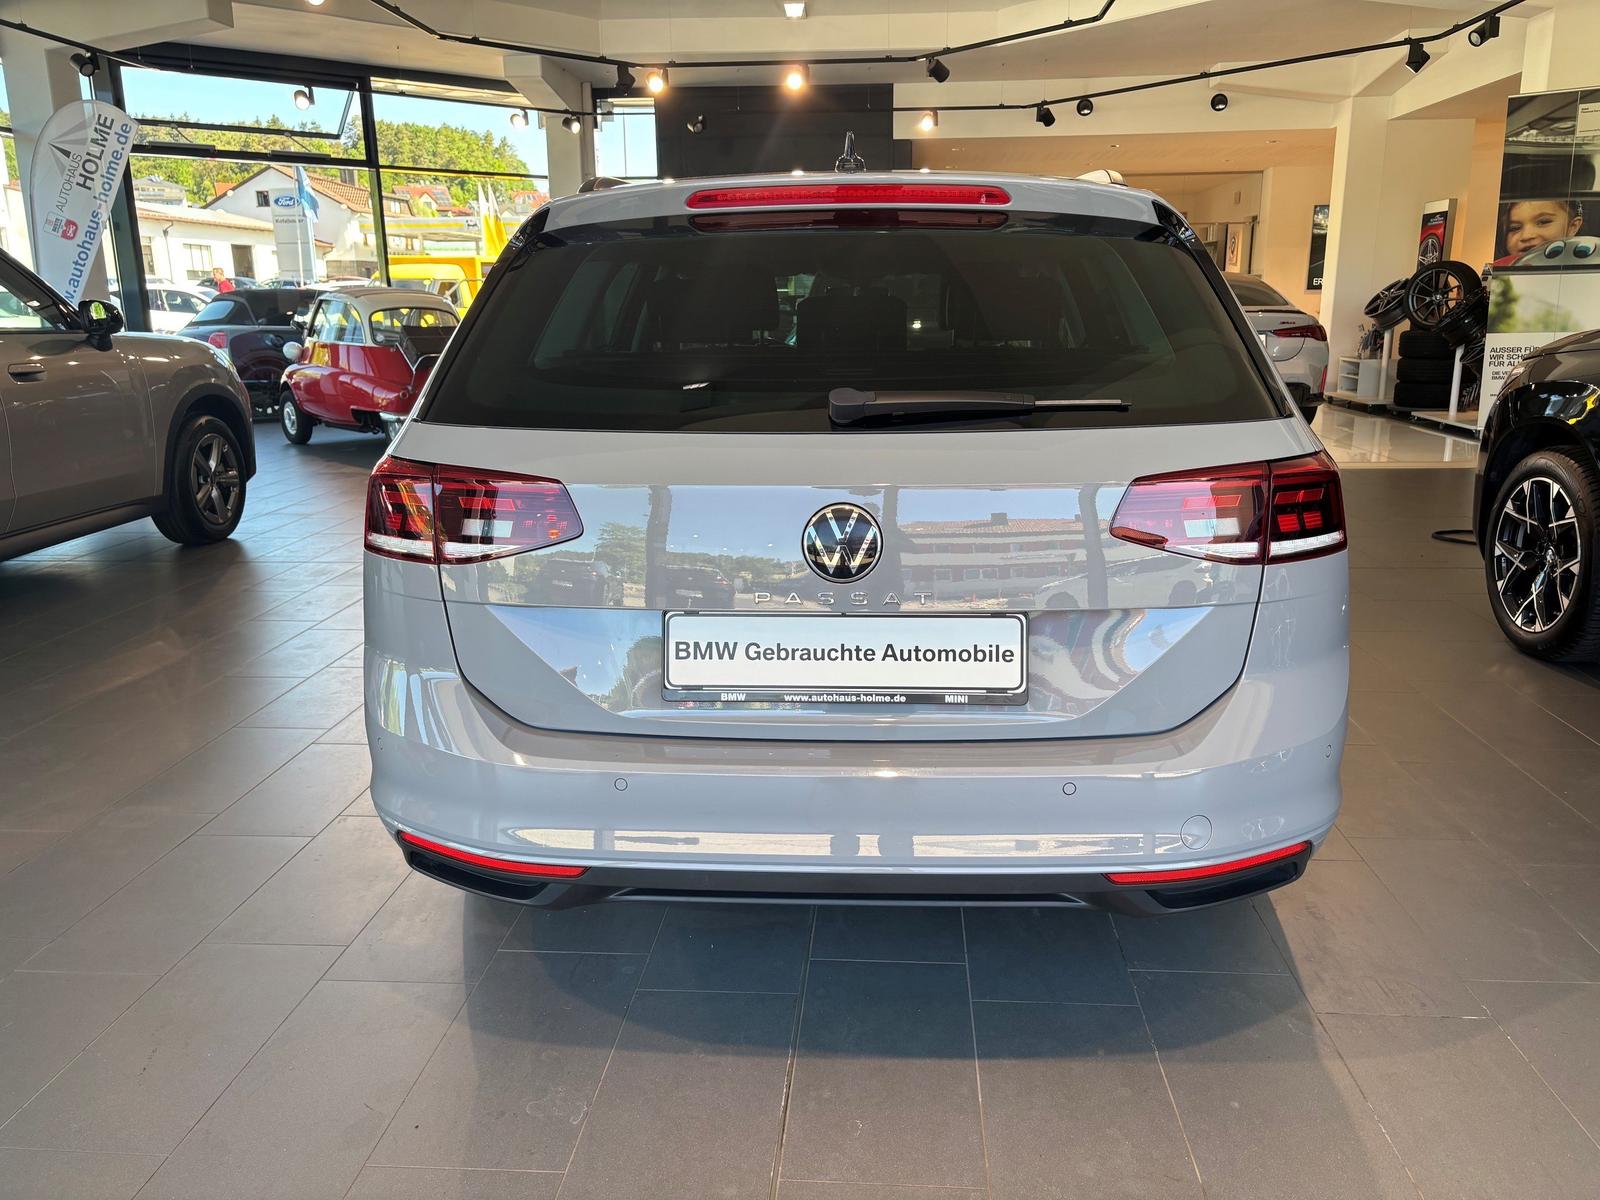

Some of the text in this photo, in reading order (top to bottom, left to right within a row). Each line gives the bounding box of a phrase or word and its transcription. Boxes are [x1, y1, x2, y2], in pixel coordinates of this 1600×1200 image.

[75, 113, 114, 191] HOLME
[56, 153, 82, 213] AUTOHAUS
[753, 591, 934, 606] PASSAT
[674, 640, 1015, 664] BMW Gebrauchte Automobile
[720, 692, 969, 704] BMW www.autohaus-holme.de MINI
